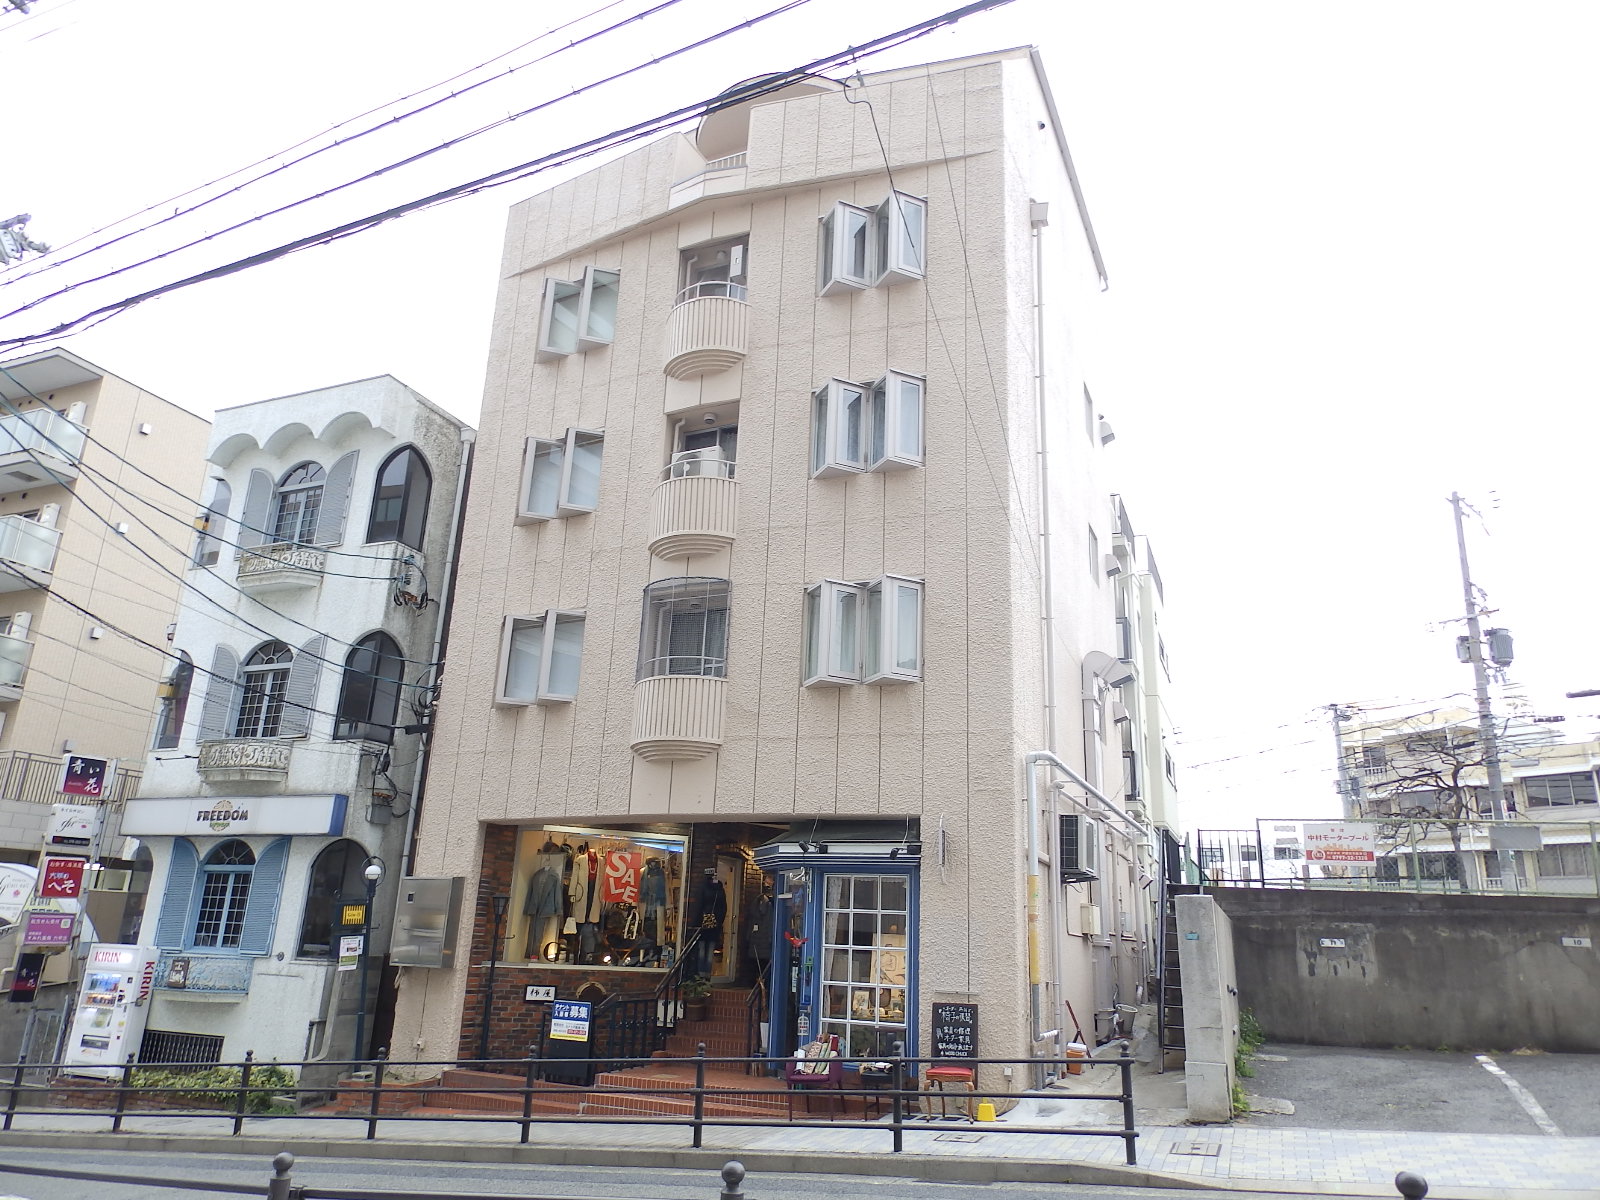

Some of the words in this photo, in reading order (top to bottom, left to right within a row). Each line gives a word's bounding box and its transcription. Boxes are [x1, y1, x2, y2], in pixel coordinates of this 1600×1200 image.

[71, 759, 100, 775] 青い
[84, 777, 99, 793] 花
[196, 810, 249, 821] FREEDOM
[605, 853, 638, 903] SALE
[47, 879, 75, 894] へそ
[94, 951, 121, 963] KIRIN
[139, 961, 155, 1001] KIRIN
[570, 1005, 588, 1018] 募集
